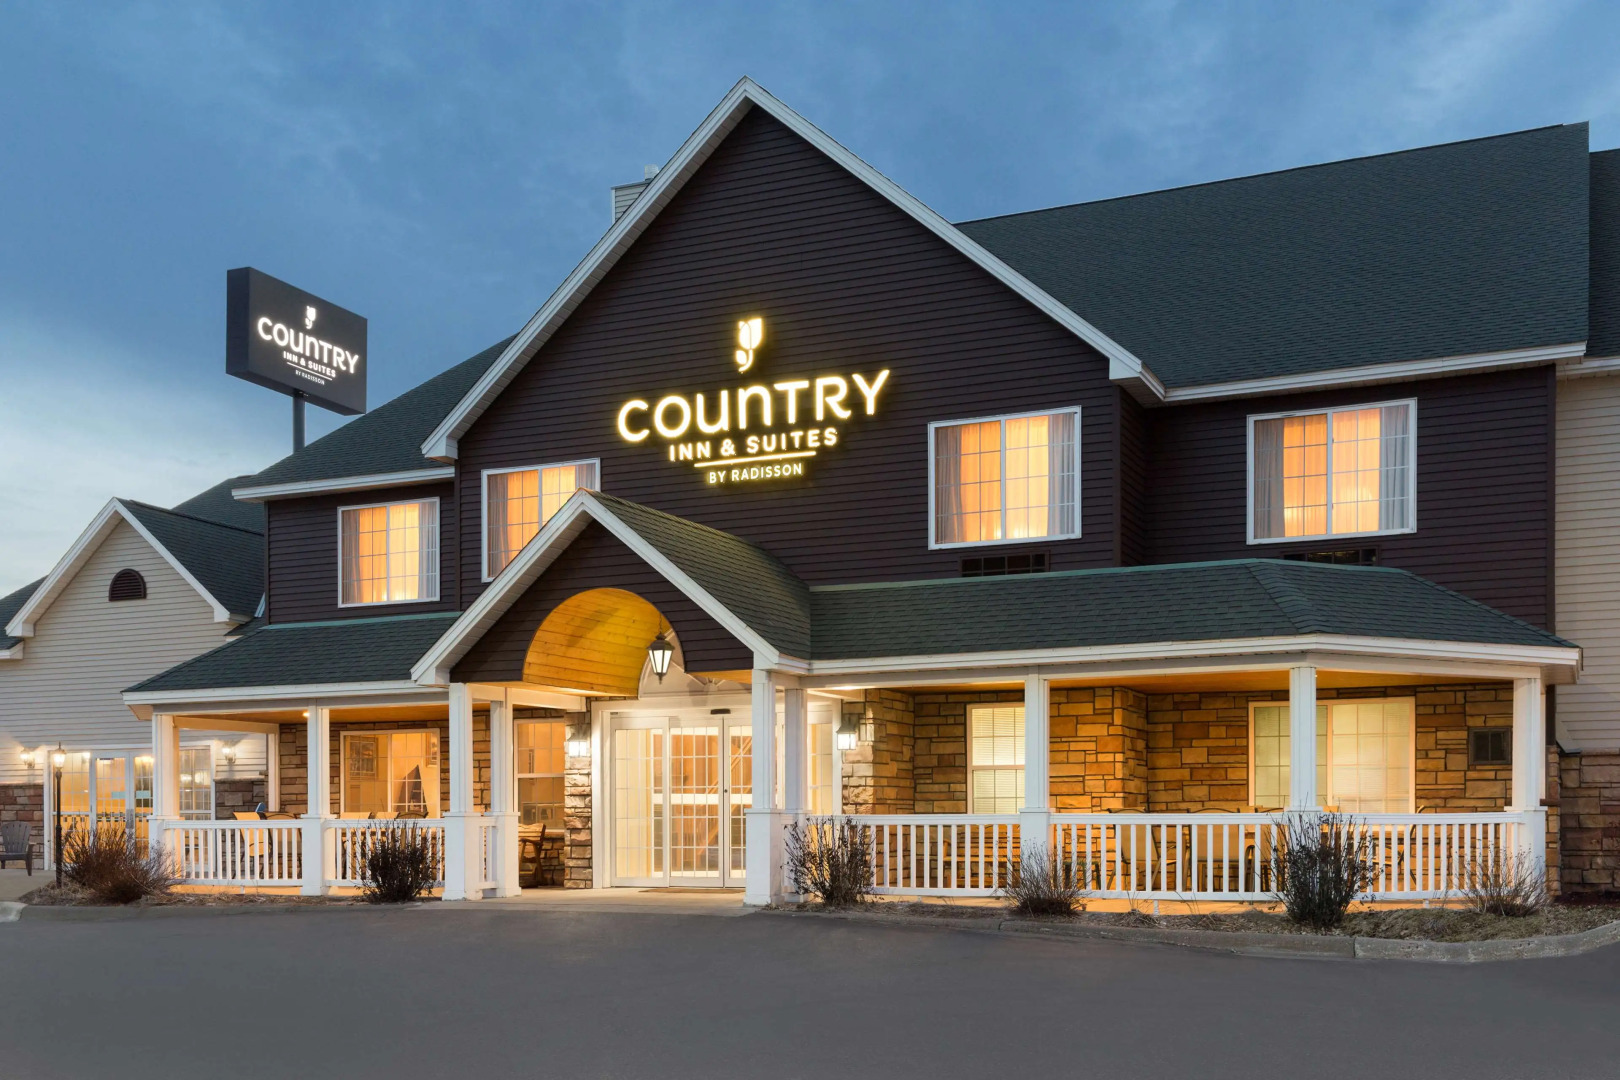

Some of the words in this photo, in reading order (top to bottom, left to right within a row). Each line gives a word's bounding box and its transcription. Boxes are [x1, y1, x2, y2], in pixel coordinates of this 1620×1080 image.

[283, 351, 298, 363] INN
[300, 357, 306, 366] &
[308, 360, 336, 377] SUITES
[301, 371, 325, 385] RADISSON
[669, 441, 710, 462] INN
[720, 438, 736, 456] &
[747, 427, 838, 453] SUITES
[708, 470, 725, 484] BY
[731, 463, 803, 482] RADISSON
